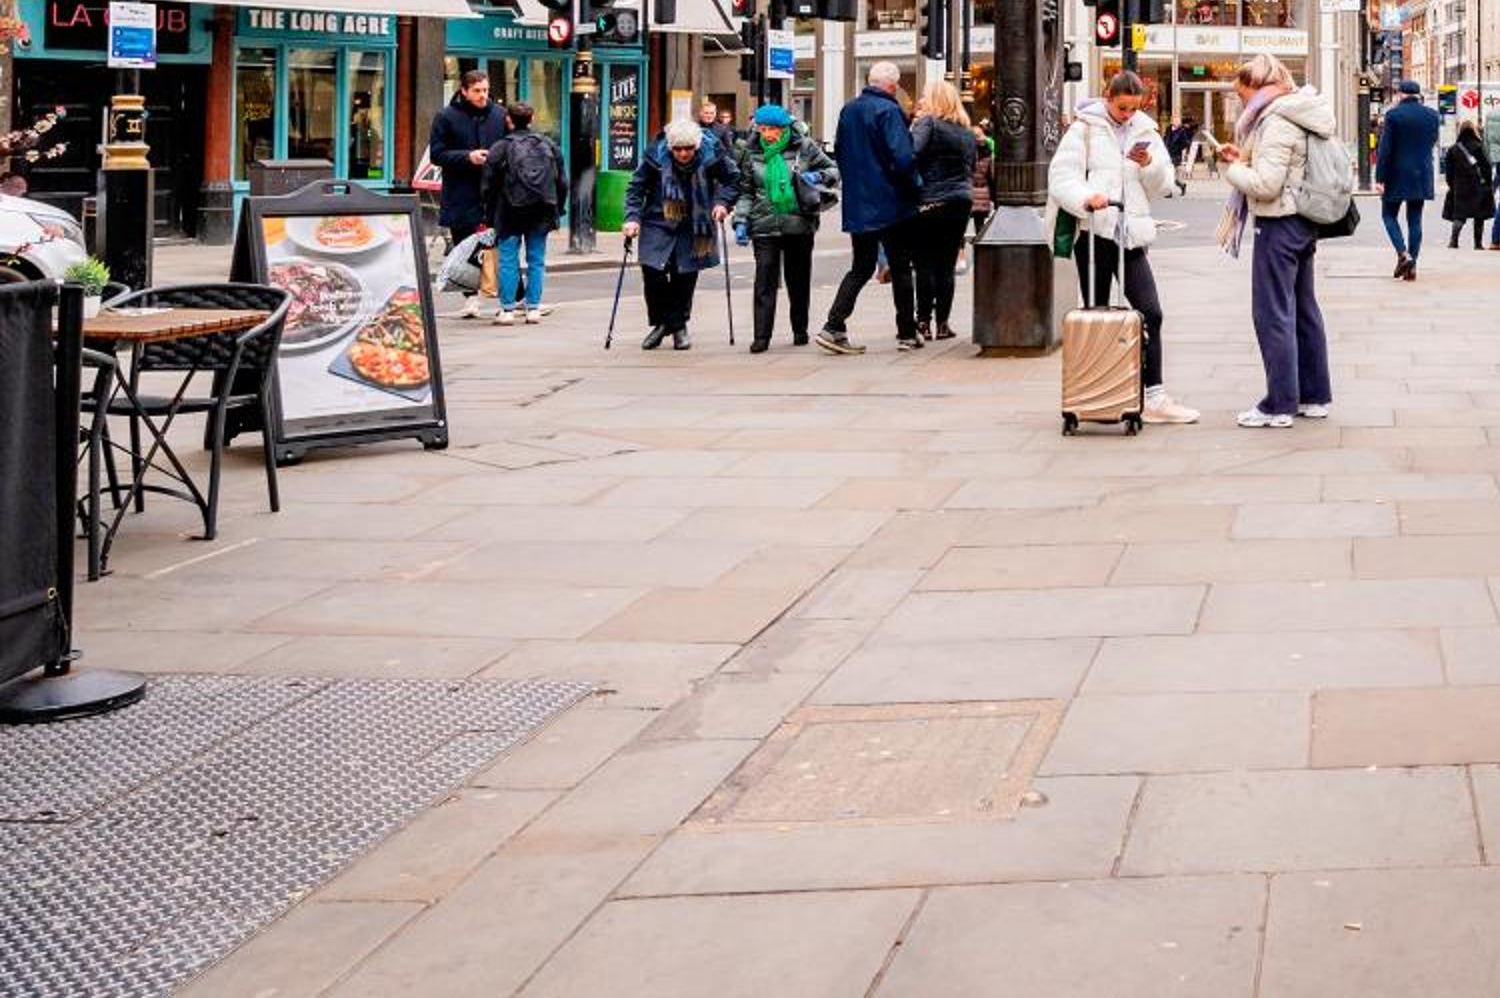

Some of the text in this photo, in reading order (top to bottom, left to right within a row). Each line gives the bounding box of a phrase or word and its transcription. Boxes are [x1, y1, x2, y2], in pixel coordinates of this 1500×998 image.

[53, 3, 92, 27] LA
[249, 9, 390, 36] THE LONG ACRE
[493, 27, 523, 39] CRAFT
[611, 75, 637, 103] LIVE
